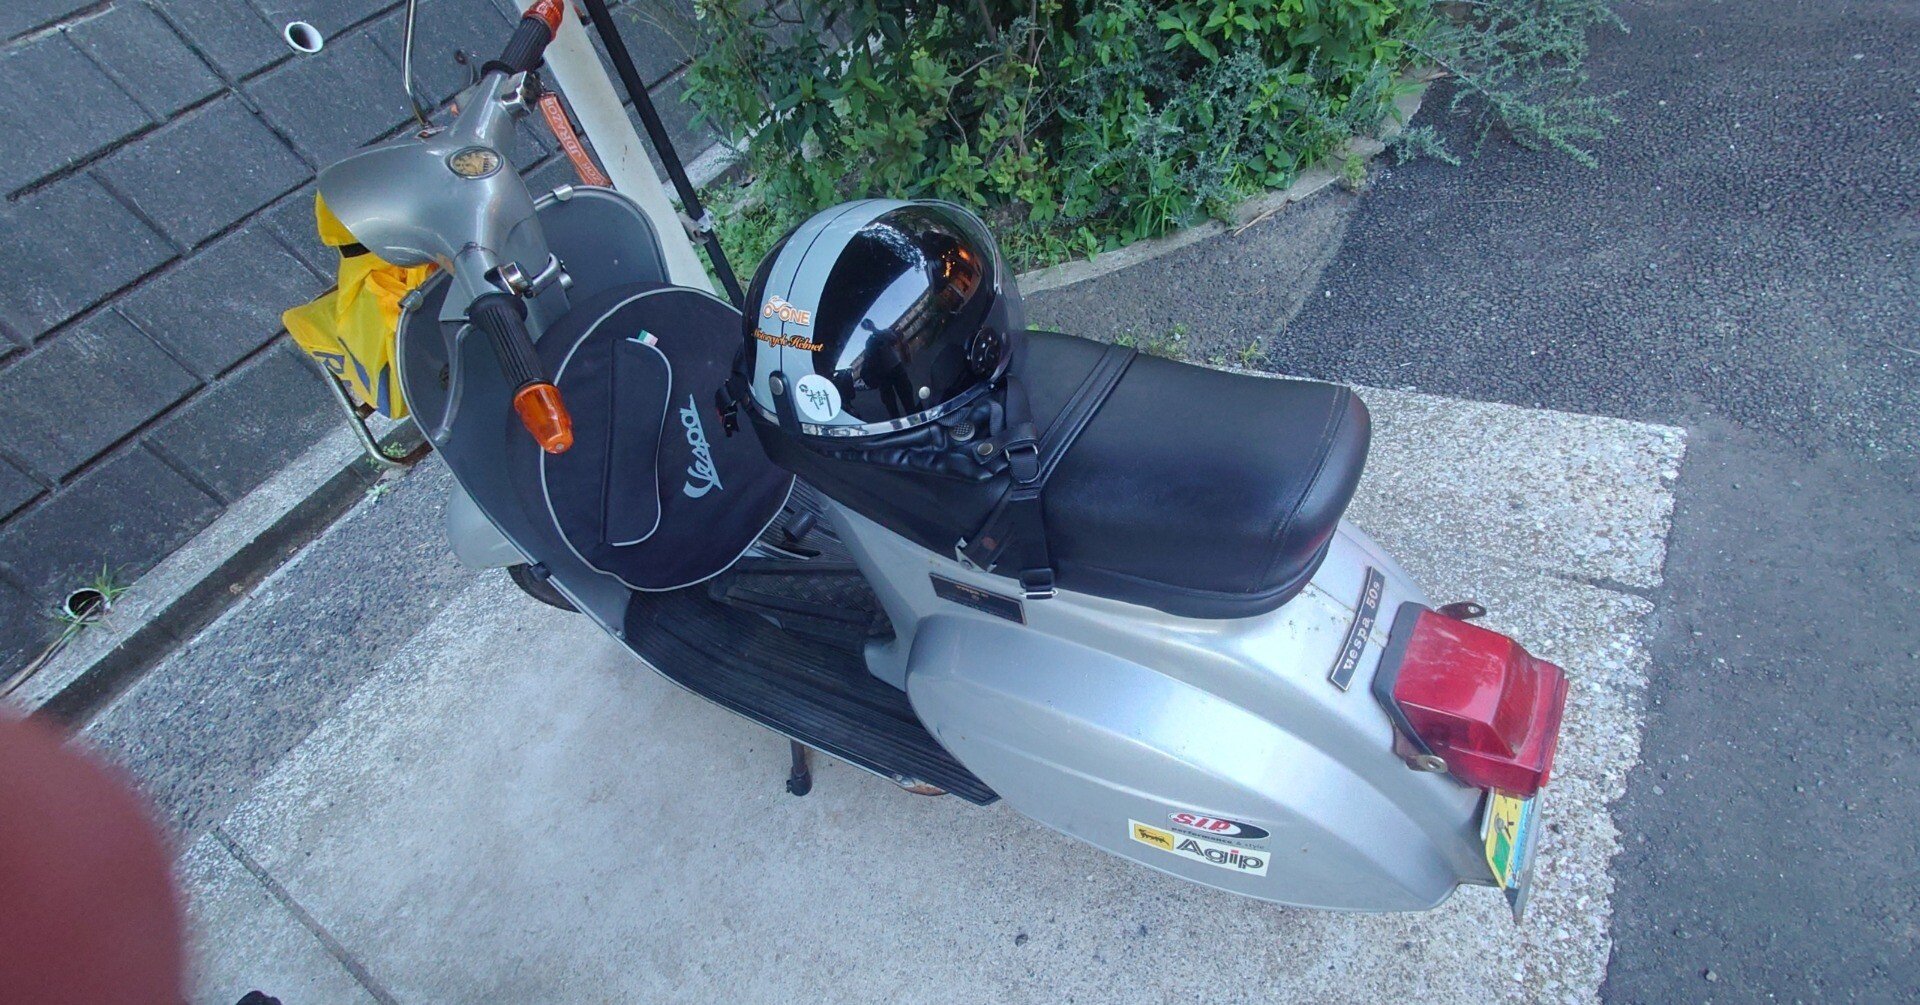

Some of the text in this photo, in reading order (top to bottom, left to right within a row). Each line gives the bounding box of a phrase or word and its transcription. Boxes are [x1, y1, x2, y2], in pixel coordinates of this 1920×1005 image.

[789, 335, 824, 352] Helmet
[679, 393, 723, 498] Vespa
[1176, 838, 1264, 869] Agip
